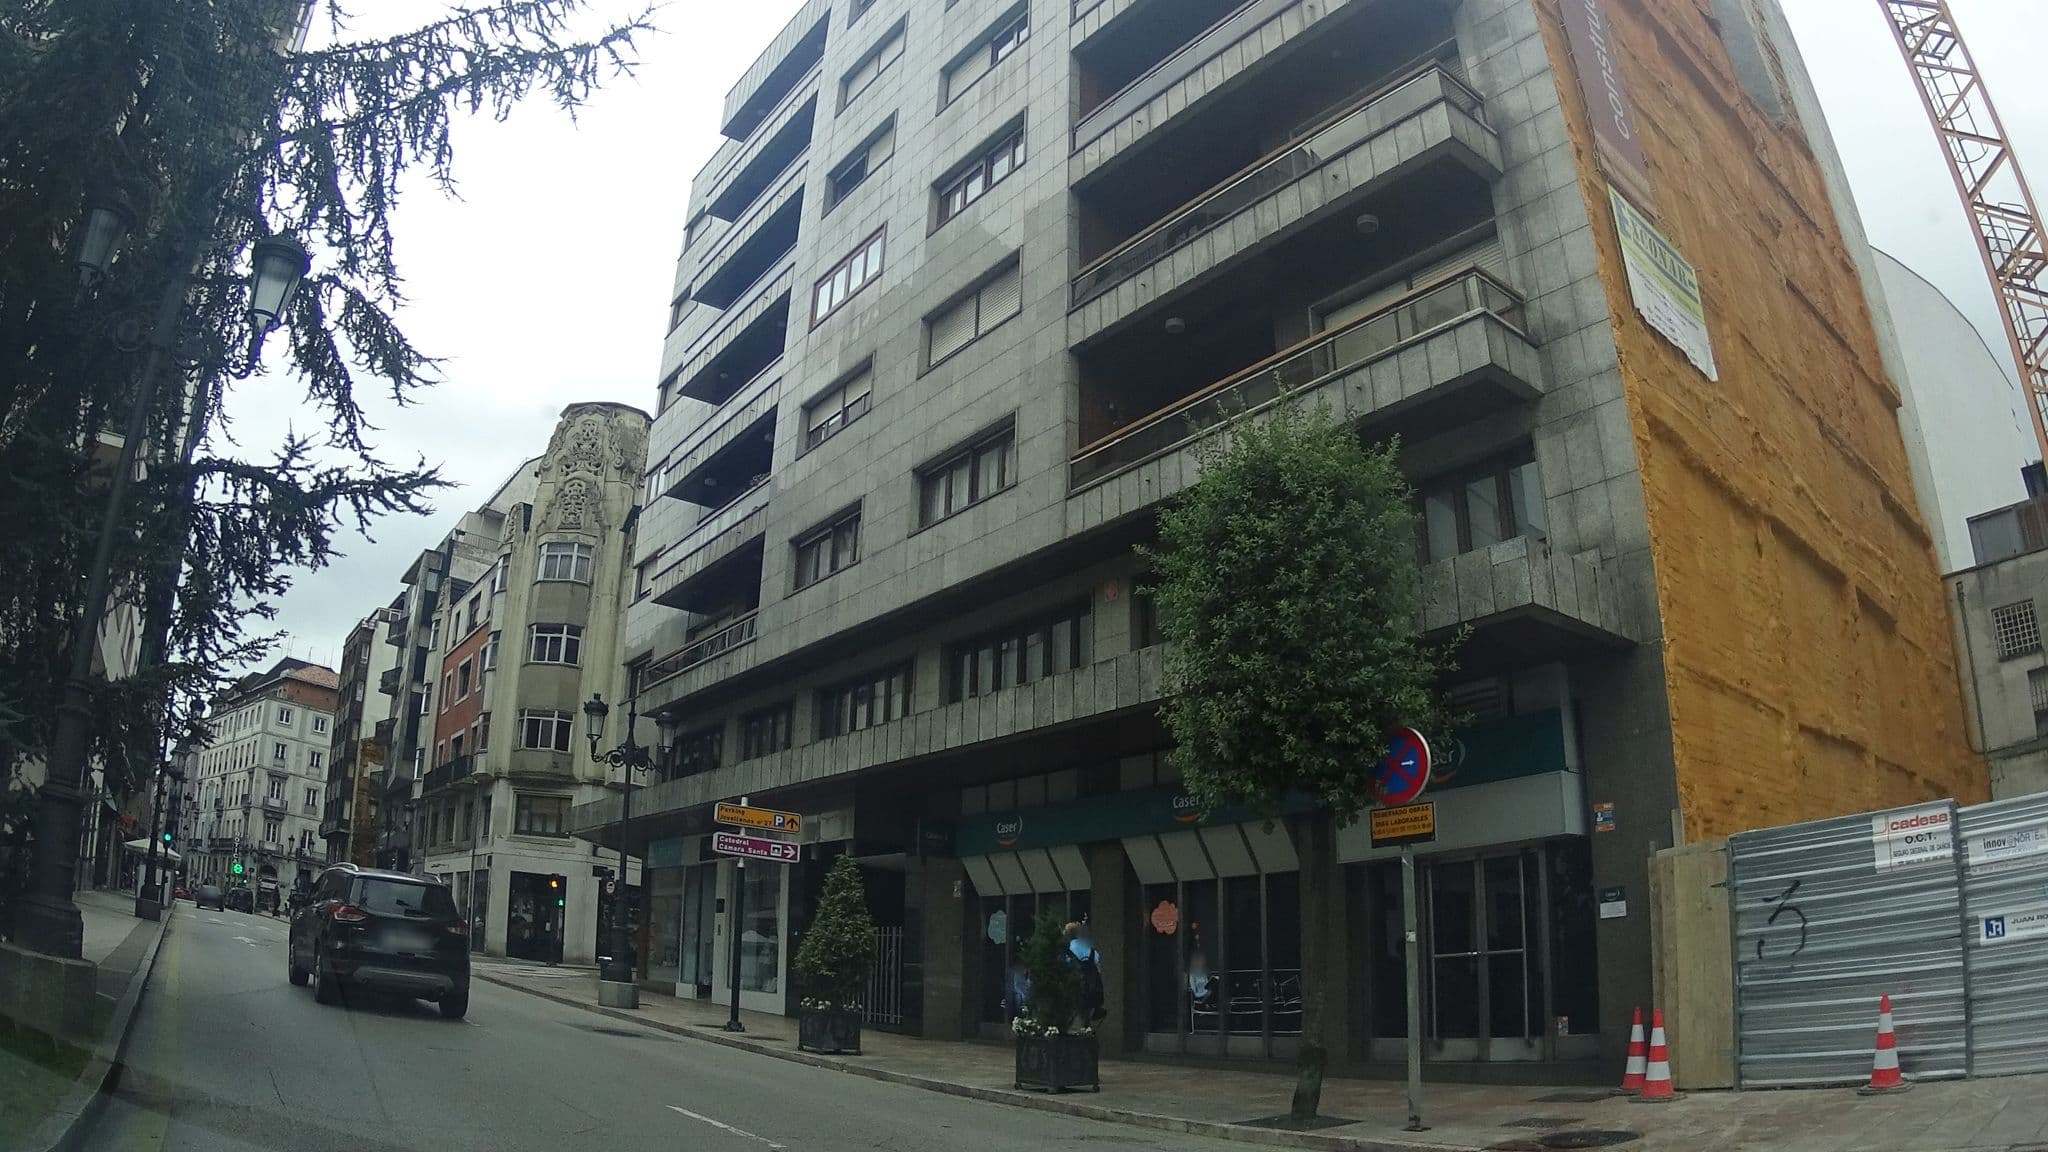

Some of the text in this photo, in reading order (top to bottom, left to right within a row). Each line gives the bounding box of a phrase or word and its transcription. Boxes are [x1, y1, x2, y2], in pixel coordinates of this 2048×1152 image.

[1172, 795, 1201, 809] Caser
[720, 807, 746, 816] Parking
[996, 822, 1017, 834] Caser
[1890, 813, 1948, 831] cadesa
[719, 835, 750, 846] Catedral
[1904, 832, 1937, 844] O.C.T.
[747, 847, 768, 856] Santa
